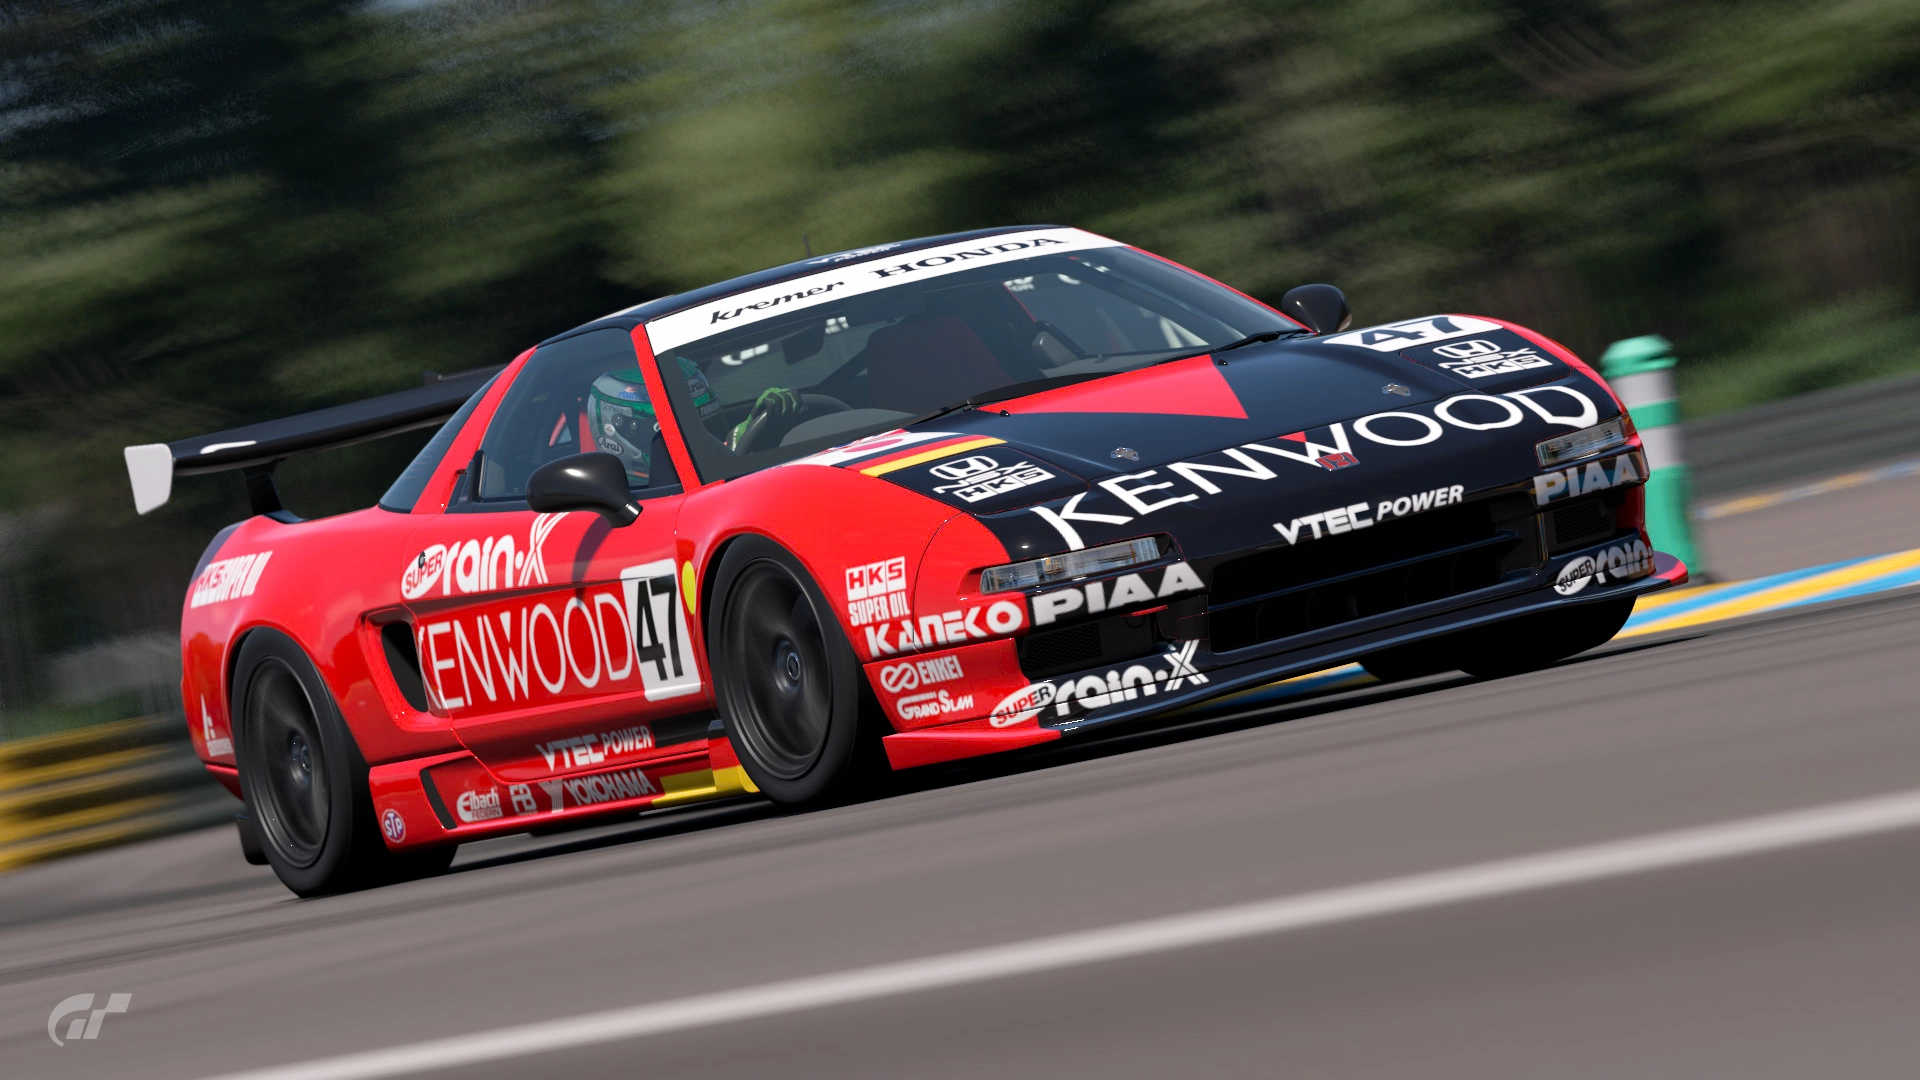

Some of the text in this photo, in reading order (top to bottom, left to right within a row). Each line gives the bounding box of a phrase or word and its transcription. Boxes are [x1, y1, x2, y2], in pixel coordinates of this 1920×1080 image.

[710, 281, 845, 325] kremer
[869, 236, 1069, 279] HONDA
[1361, 315, 1466, 346] 47
[1438, 347, 1538, 370] NSX
[1454, 355, 1549, 377] HKS
[932, 460, 1035, 494] NSX
[954, 468, 1051, 501] HKS
[1028, 385, 1598, 551] KENWOOD
[1533, 452, 1639, 506] PIAA
[1273, 484, 1464, 546] VTEC POWER
[404, 550, 445, 594] SUPER
[847, 558, 905, 595] HKS
[1558, 559, 1594, 592] SUPER
[848, 591, 910, 627] SUPER OIL
[1031, 562, 1206, 626] PIAA
[637, 573, 684, 681] 47
[865, 600, 1023, 659] KANEKO
[916, 655, 964, 685] ENKEI
[897, 690, 974, 720] GRAND SLAM
[995, 686, 1052, 726] SUPER
[535, 725, 653, 772] VTEC POWER
[563, 768, 657, 806] YOKOHAMA
[384, 811, 404, 840] STP
